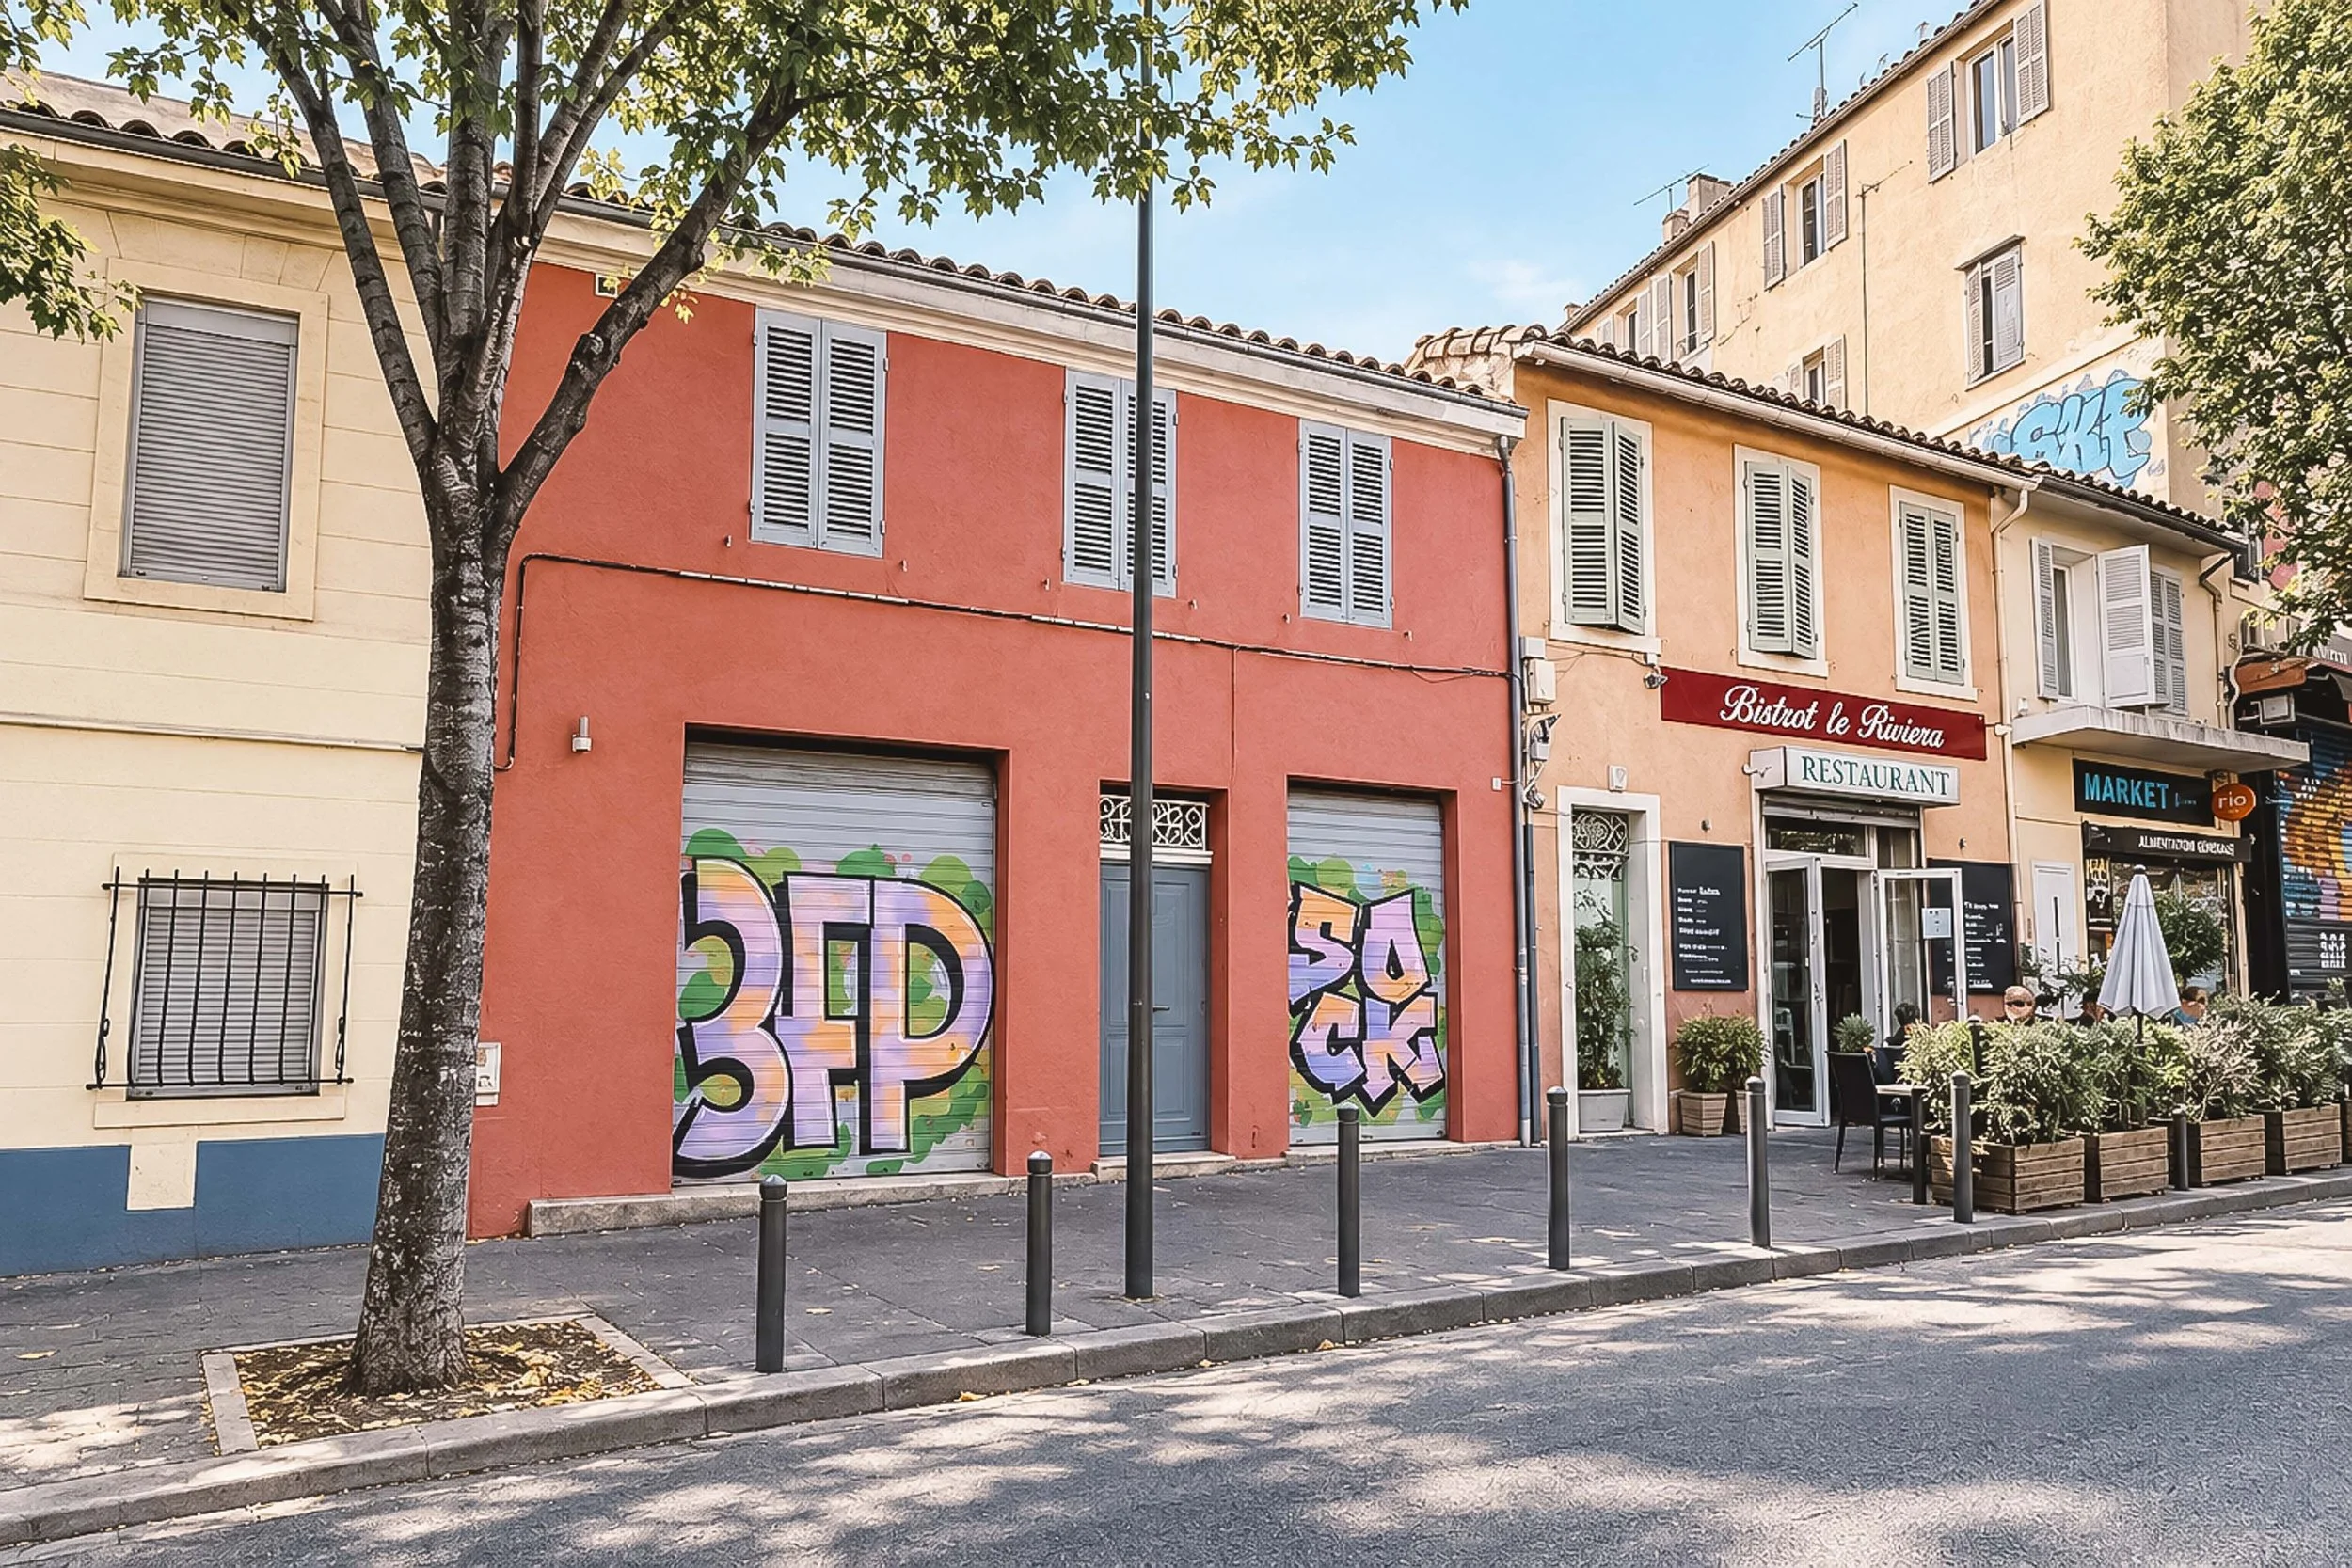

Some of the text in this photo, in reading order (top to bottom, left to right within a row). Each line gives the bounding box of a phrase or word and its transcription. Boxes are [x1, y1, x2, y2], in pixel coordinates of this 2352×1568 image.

[1720, 685, 1945, 749] Bistrot le Riviera
[1801, 755, 1949, 796] RESTAURANT
[2084, 772, 2169, 810] MARKET
[2217, 790, 2248, 809] rio
